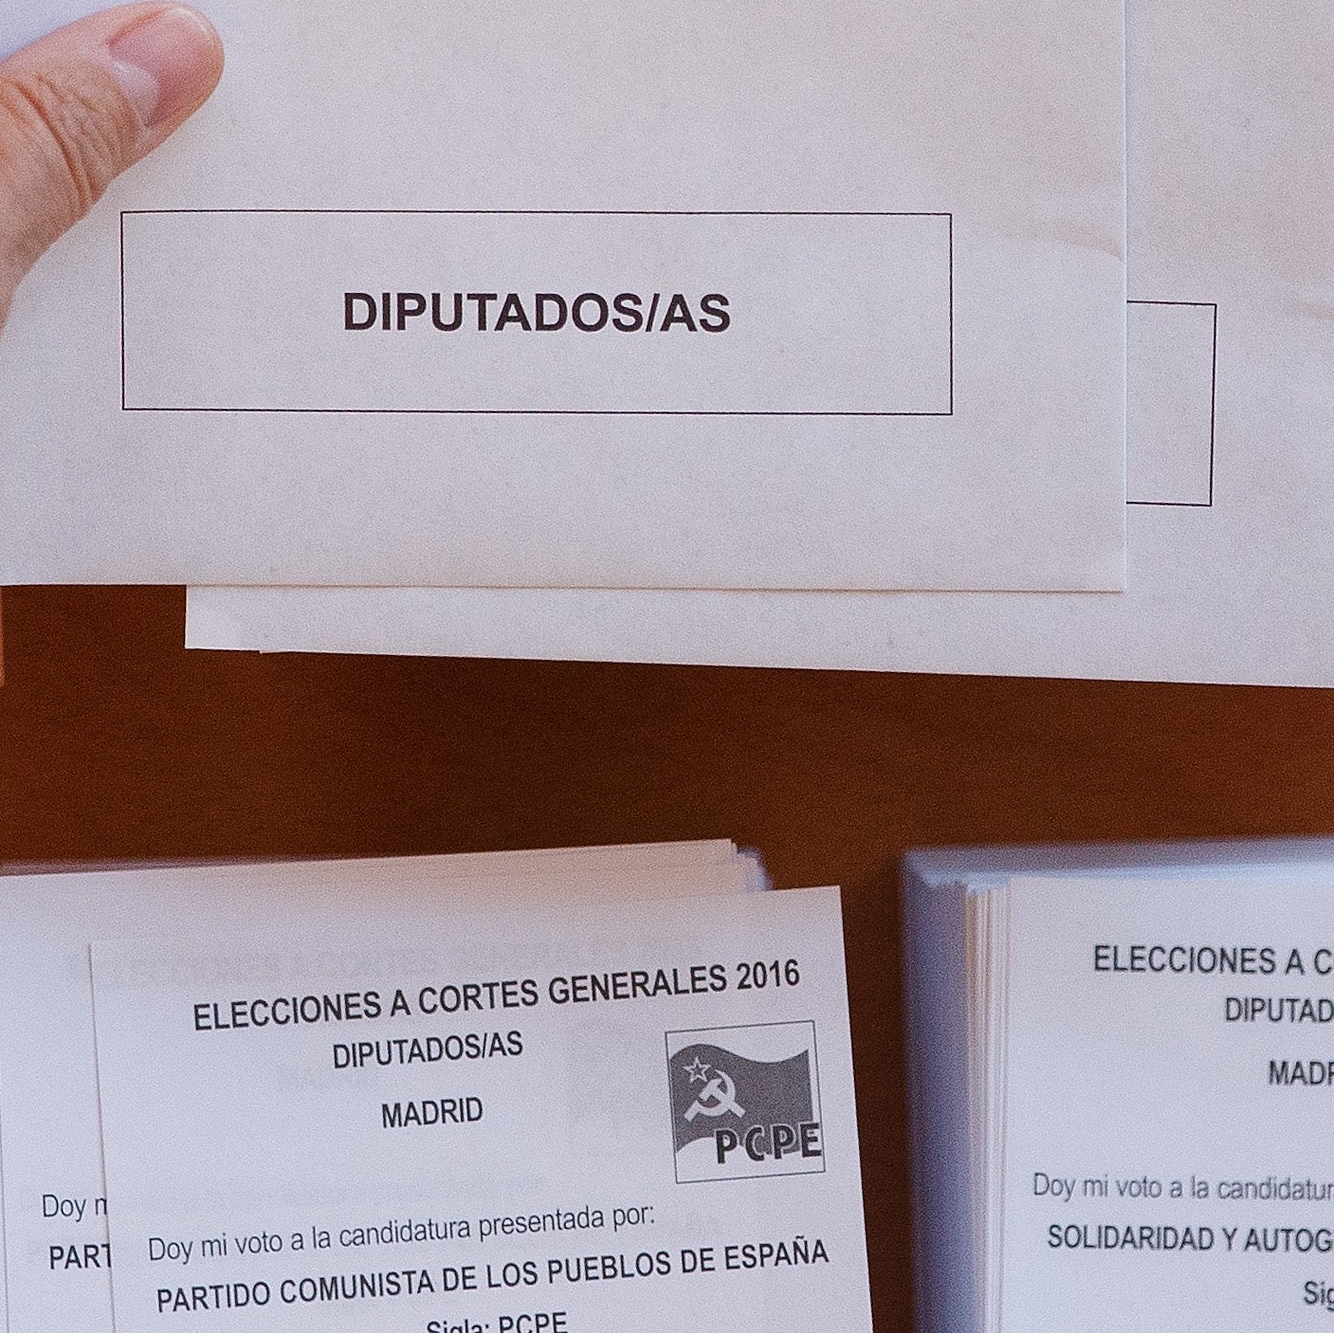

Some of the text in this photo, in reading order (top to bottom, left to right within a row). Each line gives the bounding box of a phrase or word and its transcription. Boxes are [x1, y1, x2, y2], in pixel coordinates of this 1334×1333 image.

[343, 291, 731, 334] DIPUTADOS/AS
[1092, 943, 1278, 977] ELECCIONES
[1283, 947, 1306, 976] A
[192, 957, 801, 1032] ELECCIONES A CORTES GENERALES 2016
[331, 1028, 525, 1071] DIPUTADOS/AS
[380, 1095, 484, 1129] MADRID
[714, 1122, 823, 1165] PCPE
[1047, 1223, 1216, 1252] SOLIDARIDAD
[1221, 1226, 1238, 1251] Y
[156, 1234, 831, 1314] PARTIDO COMUNISTA DE LOS PUEBLOS DE ESPAÑA
